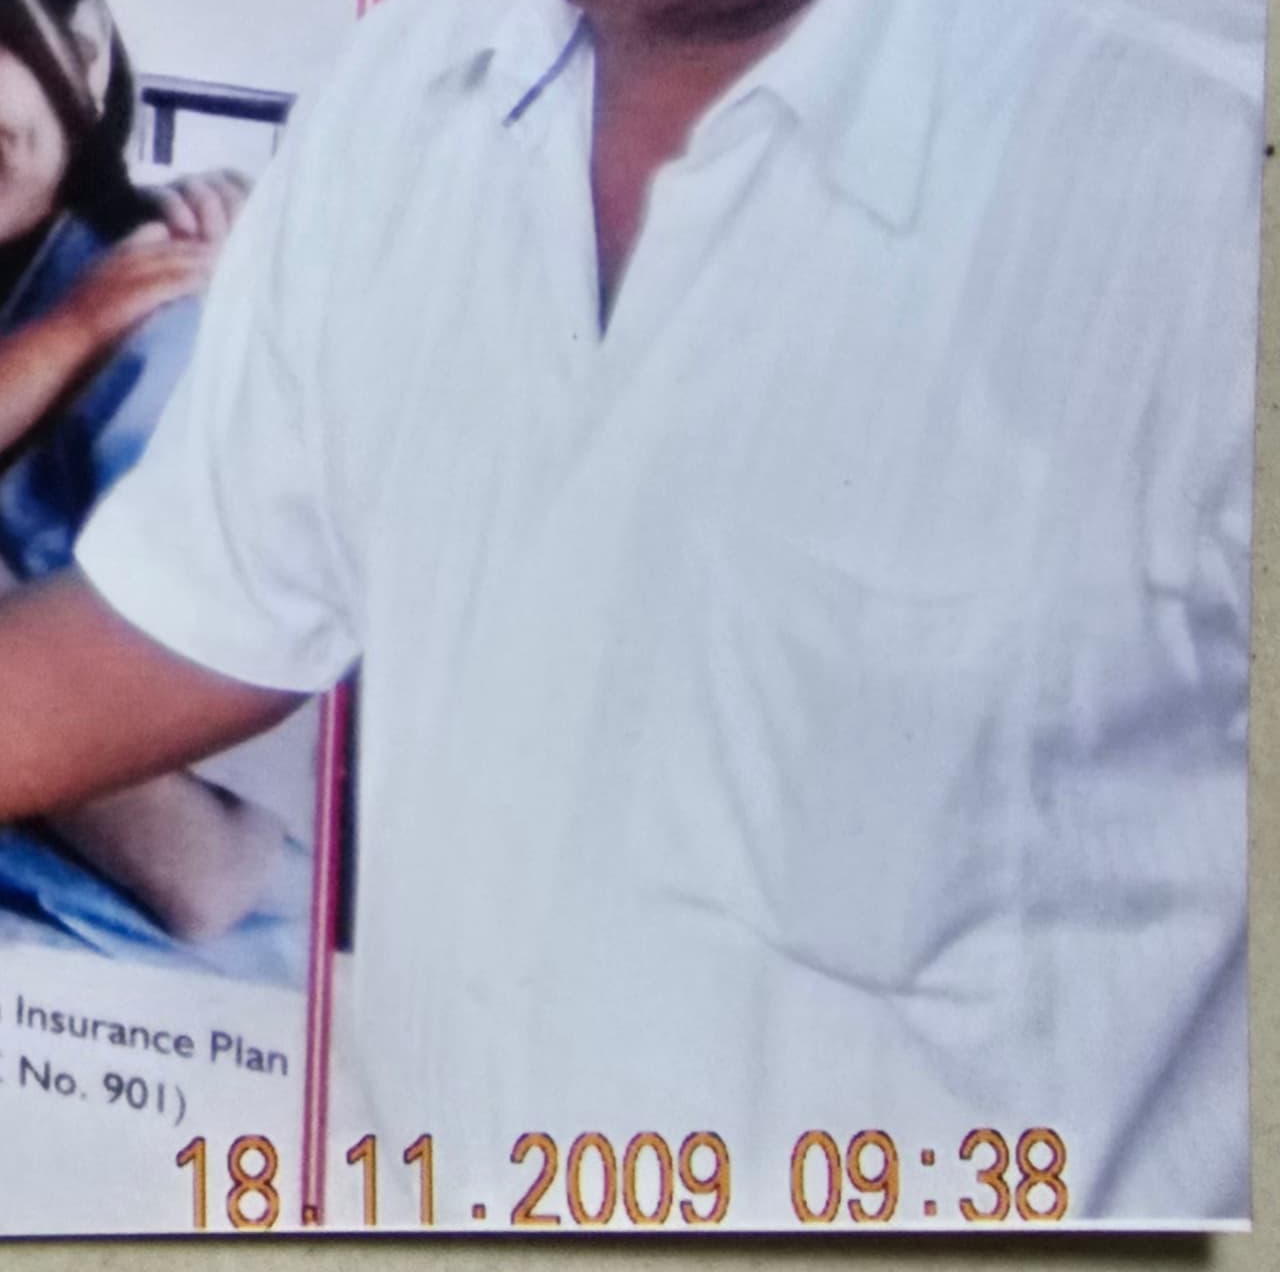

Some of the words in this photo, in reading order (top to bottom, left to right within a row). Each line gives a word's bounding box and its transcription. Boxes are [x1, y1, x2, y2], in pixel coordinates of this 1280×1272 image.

[17, 994, 195, 1059] Insurance
[210, 1029, 289, 1077] Plan
[19, 1054, 87, 1101] No.
[103, 1071, 187, 1127] 901)
